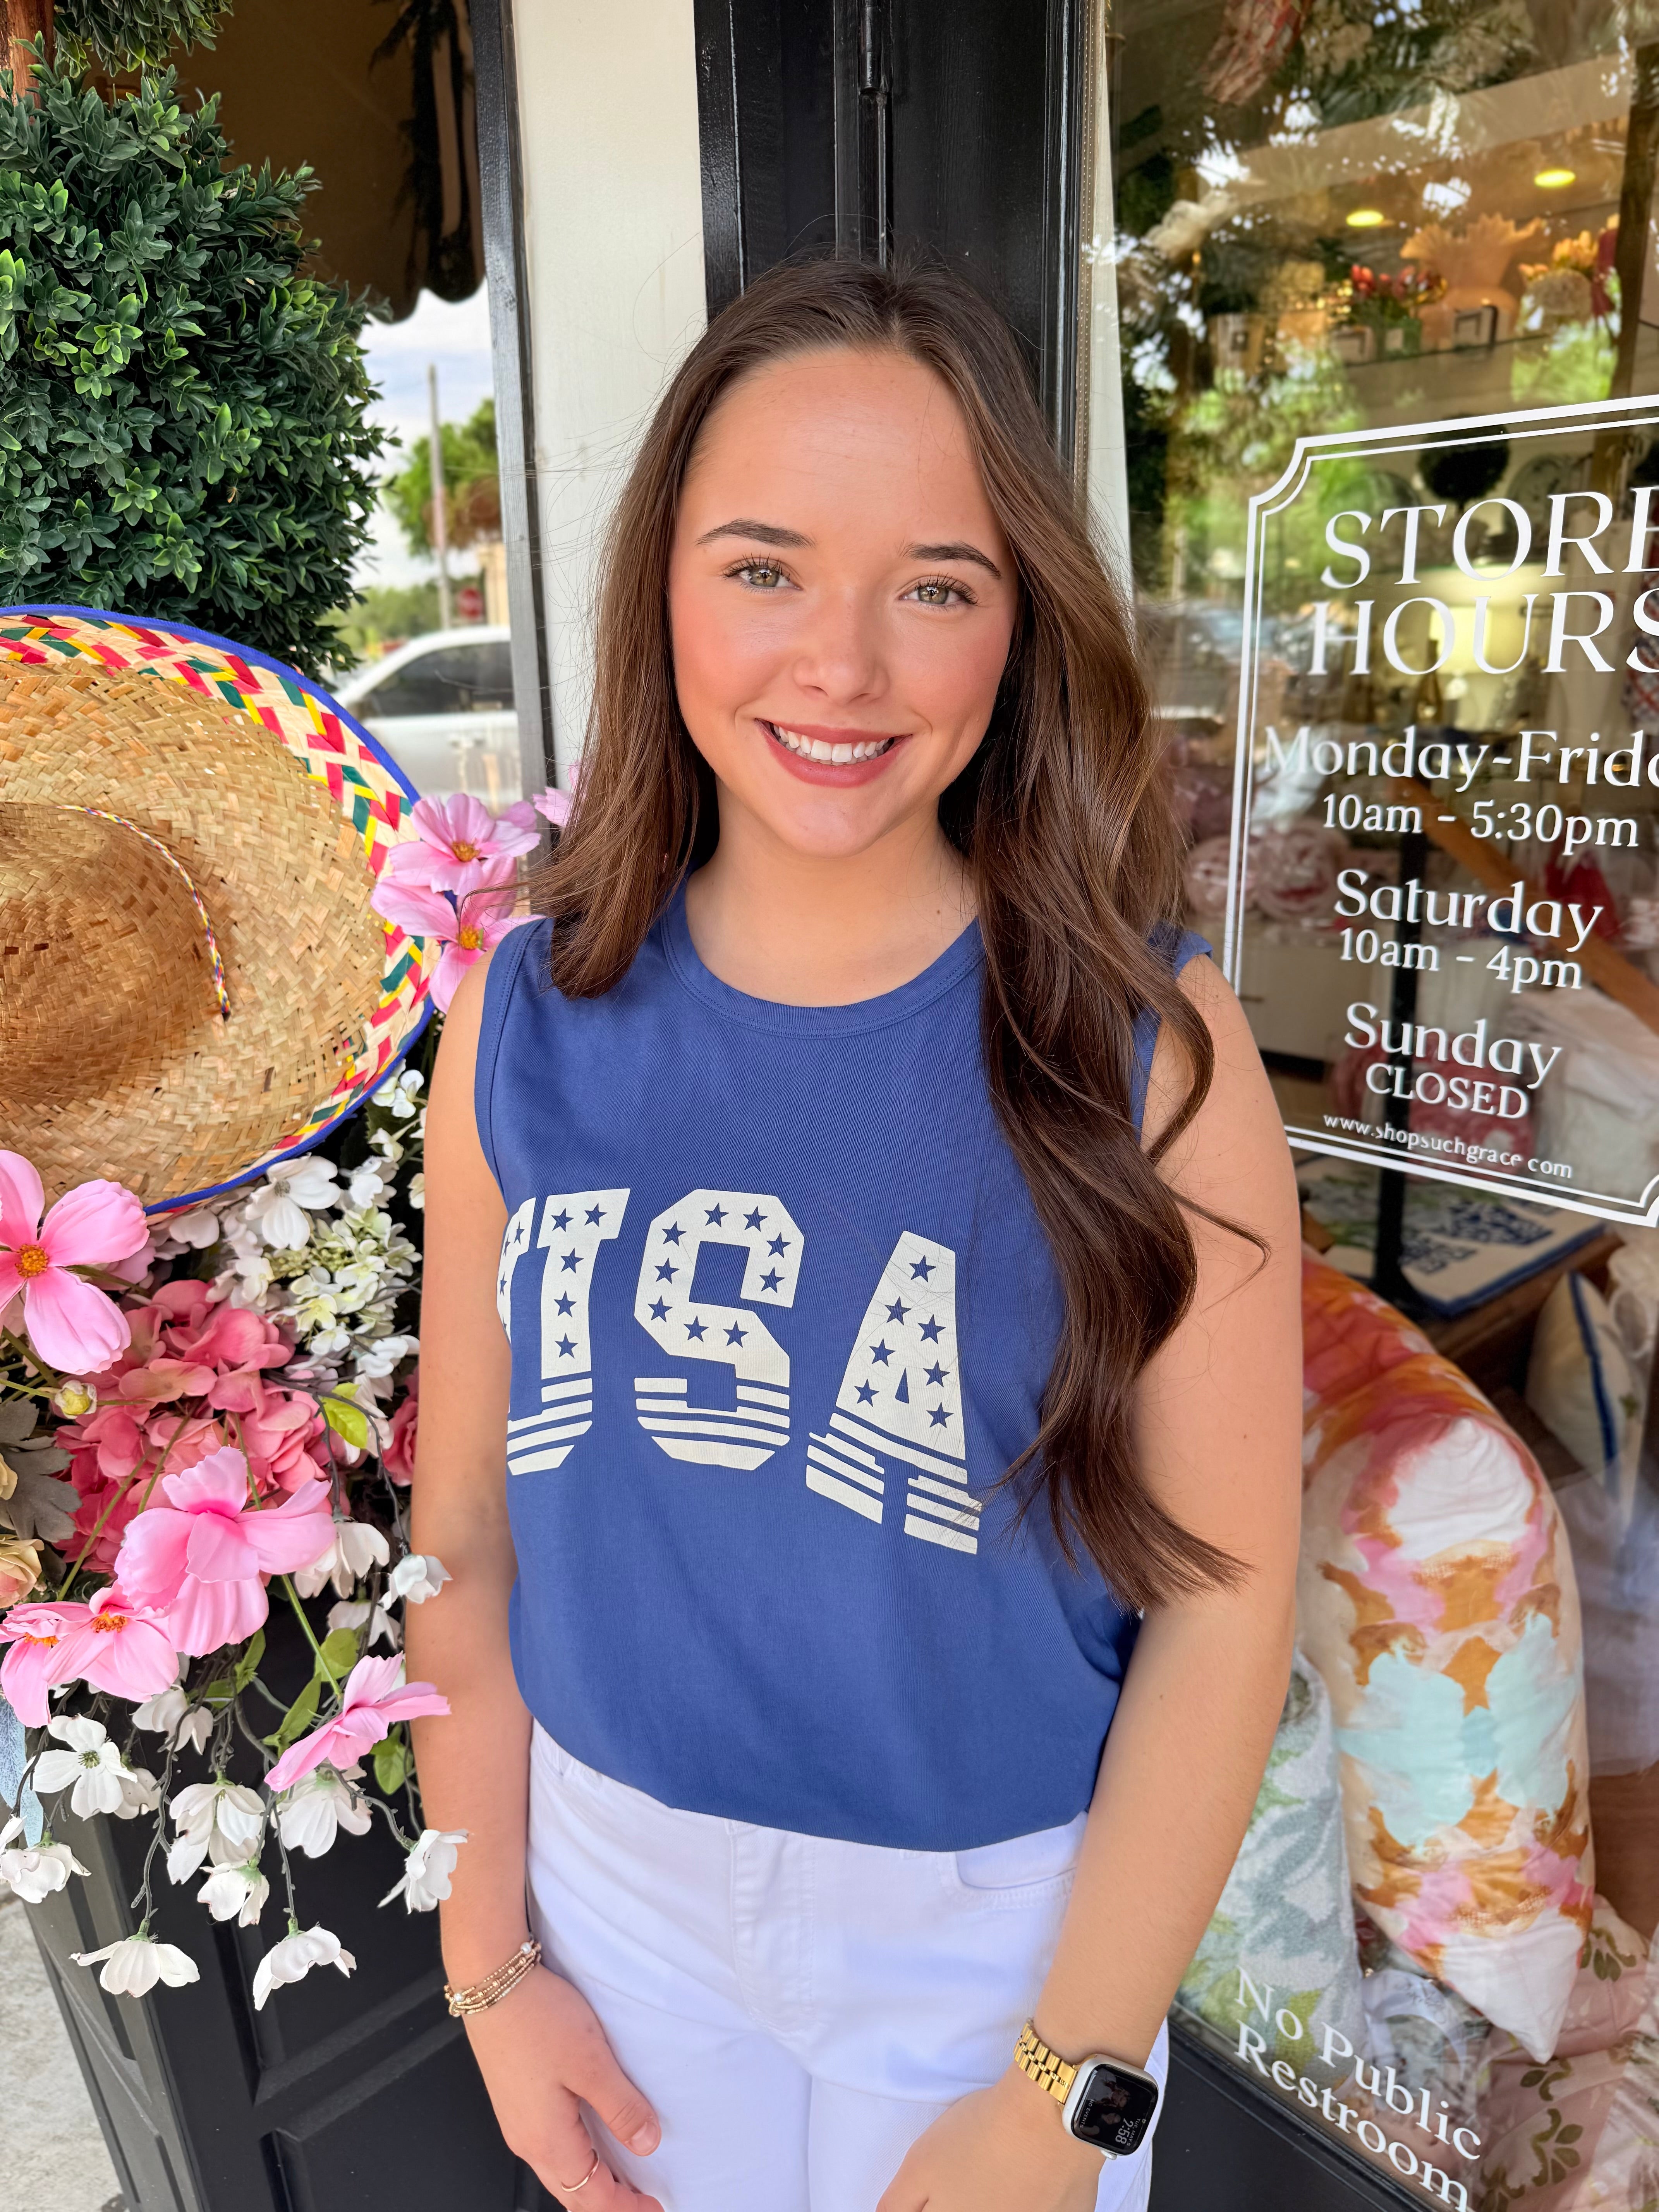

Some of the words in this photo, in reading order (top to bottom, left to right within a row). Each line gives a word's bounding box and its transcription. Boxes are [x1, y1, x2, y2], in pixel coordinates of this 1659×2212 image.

[1320, 486, 1659, 589] STORE
[1307, 588, 1659, 675] HOURS
[1323, 793, 1423, 833] 10am
[1471, 800, 1639, 856] 5:30pm
[1334, 868, 1604, 952] Saturday
[1340, 927, 1440, 972] 10am
[1486, 945, 1581, 994] 4pm
[1344, 1002, 1562, 1089] Sunday
[1365, 1062, 1529, 1120] CLOSED
[1323, 1114, 1572, 1179] www.shopsuchgracecom
[497, 1187, 982, 1554] USA
[1235, 1965, 1303, 2040] No
[1319, 2021, 1481, 2160] Public
[1079, 2108, 1091, 2128] EVENTS
[1115, 2118, 1133, 2144] 2:58
[1235, 2020, 1468, 2212] Restroom
